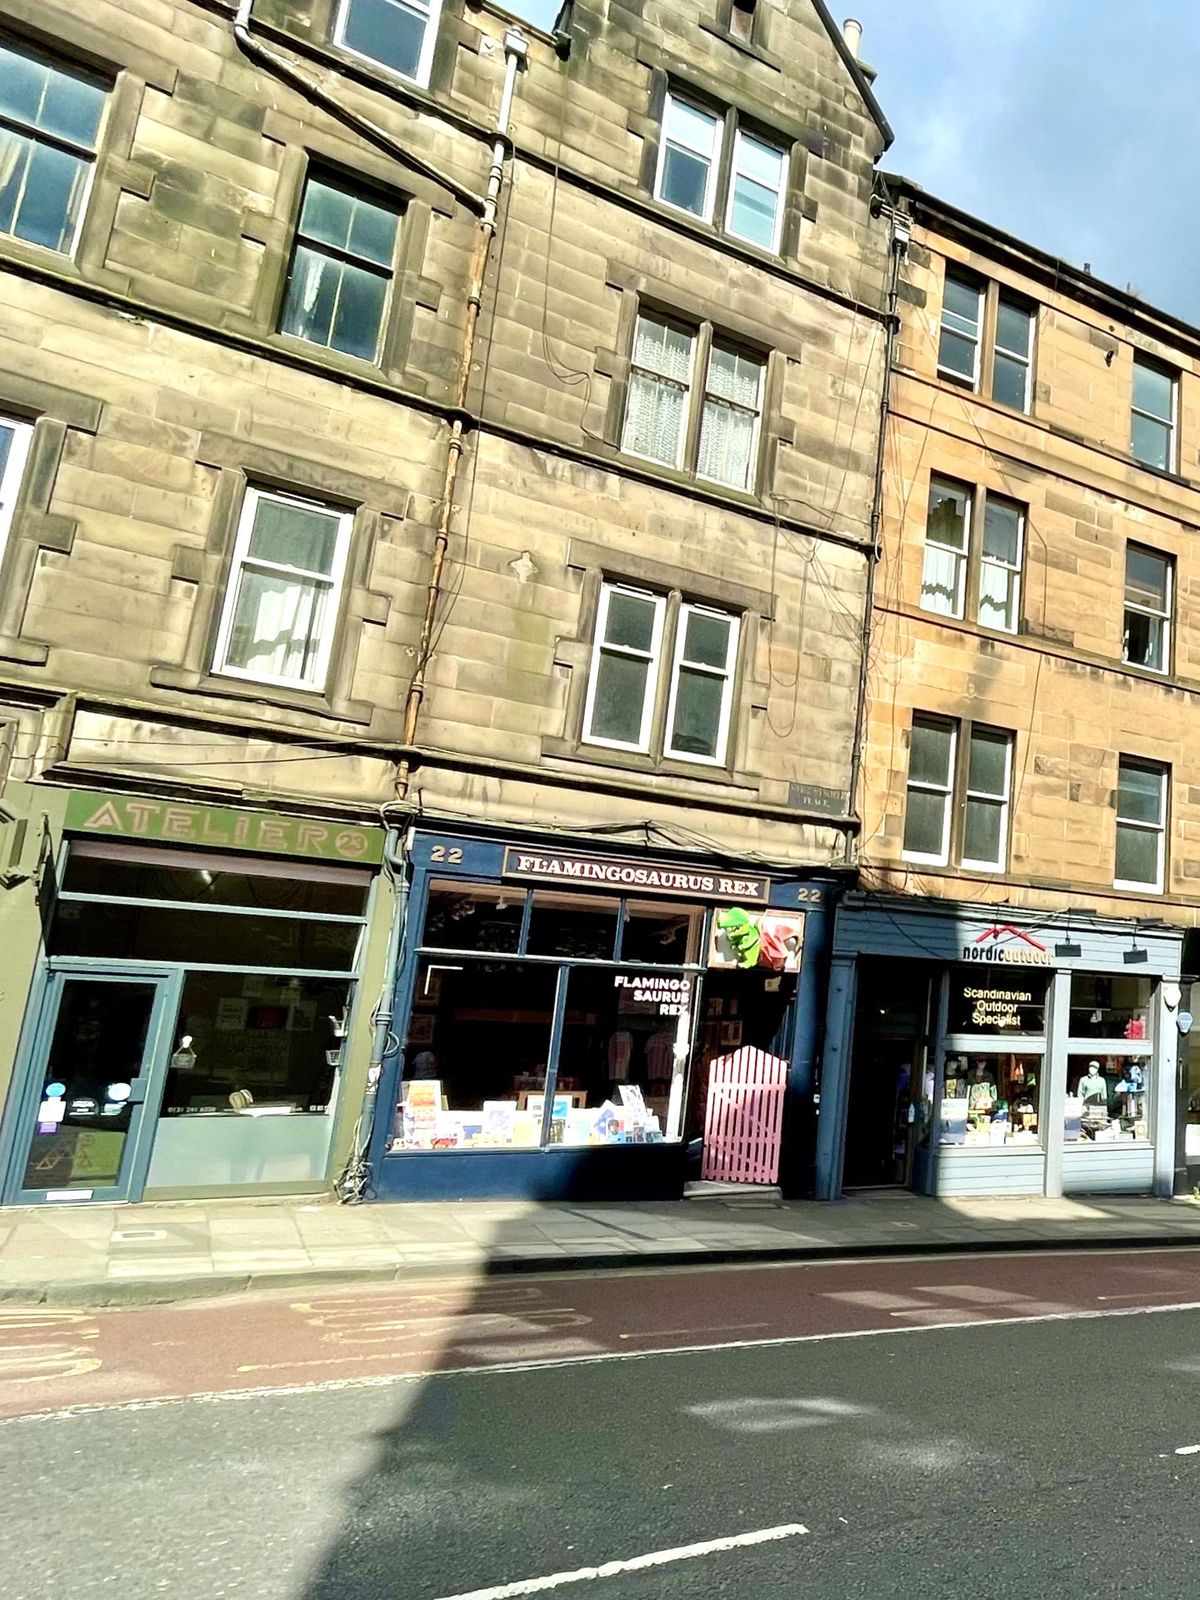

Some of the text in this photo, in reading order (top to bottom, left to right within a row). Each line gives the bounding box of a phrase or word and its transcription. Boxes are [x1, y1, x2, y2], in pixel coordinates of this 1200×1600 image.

[84, 801, 328, 854] ATELIER
[430, 845, 463, 864] 22
[518, 855, 759, 897] FLAMINGOSAURUS REX
[798, 887, 821, 902] 22
[614, 975, 691, 991] FLAMINGO
[633, 989, 690, 1004] SAURUS
[963, 986, 1032, 1002] Scandinavian
[659, 1003, 689, 1016] REX
[976, 1000, 1019, 1014] Outdoor
[971, 1012, 1021, 1028] Specialist
